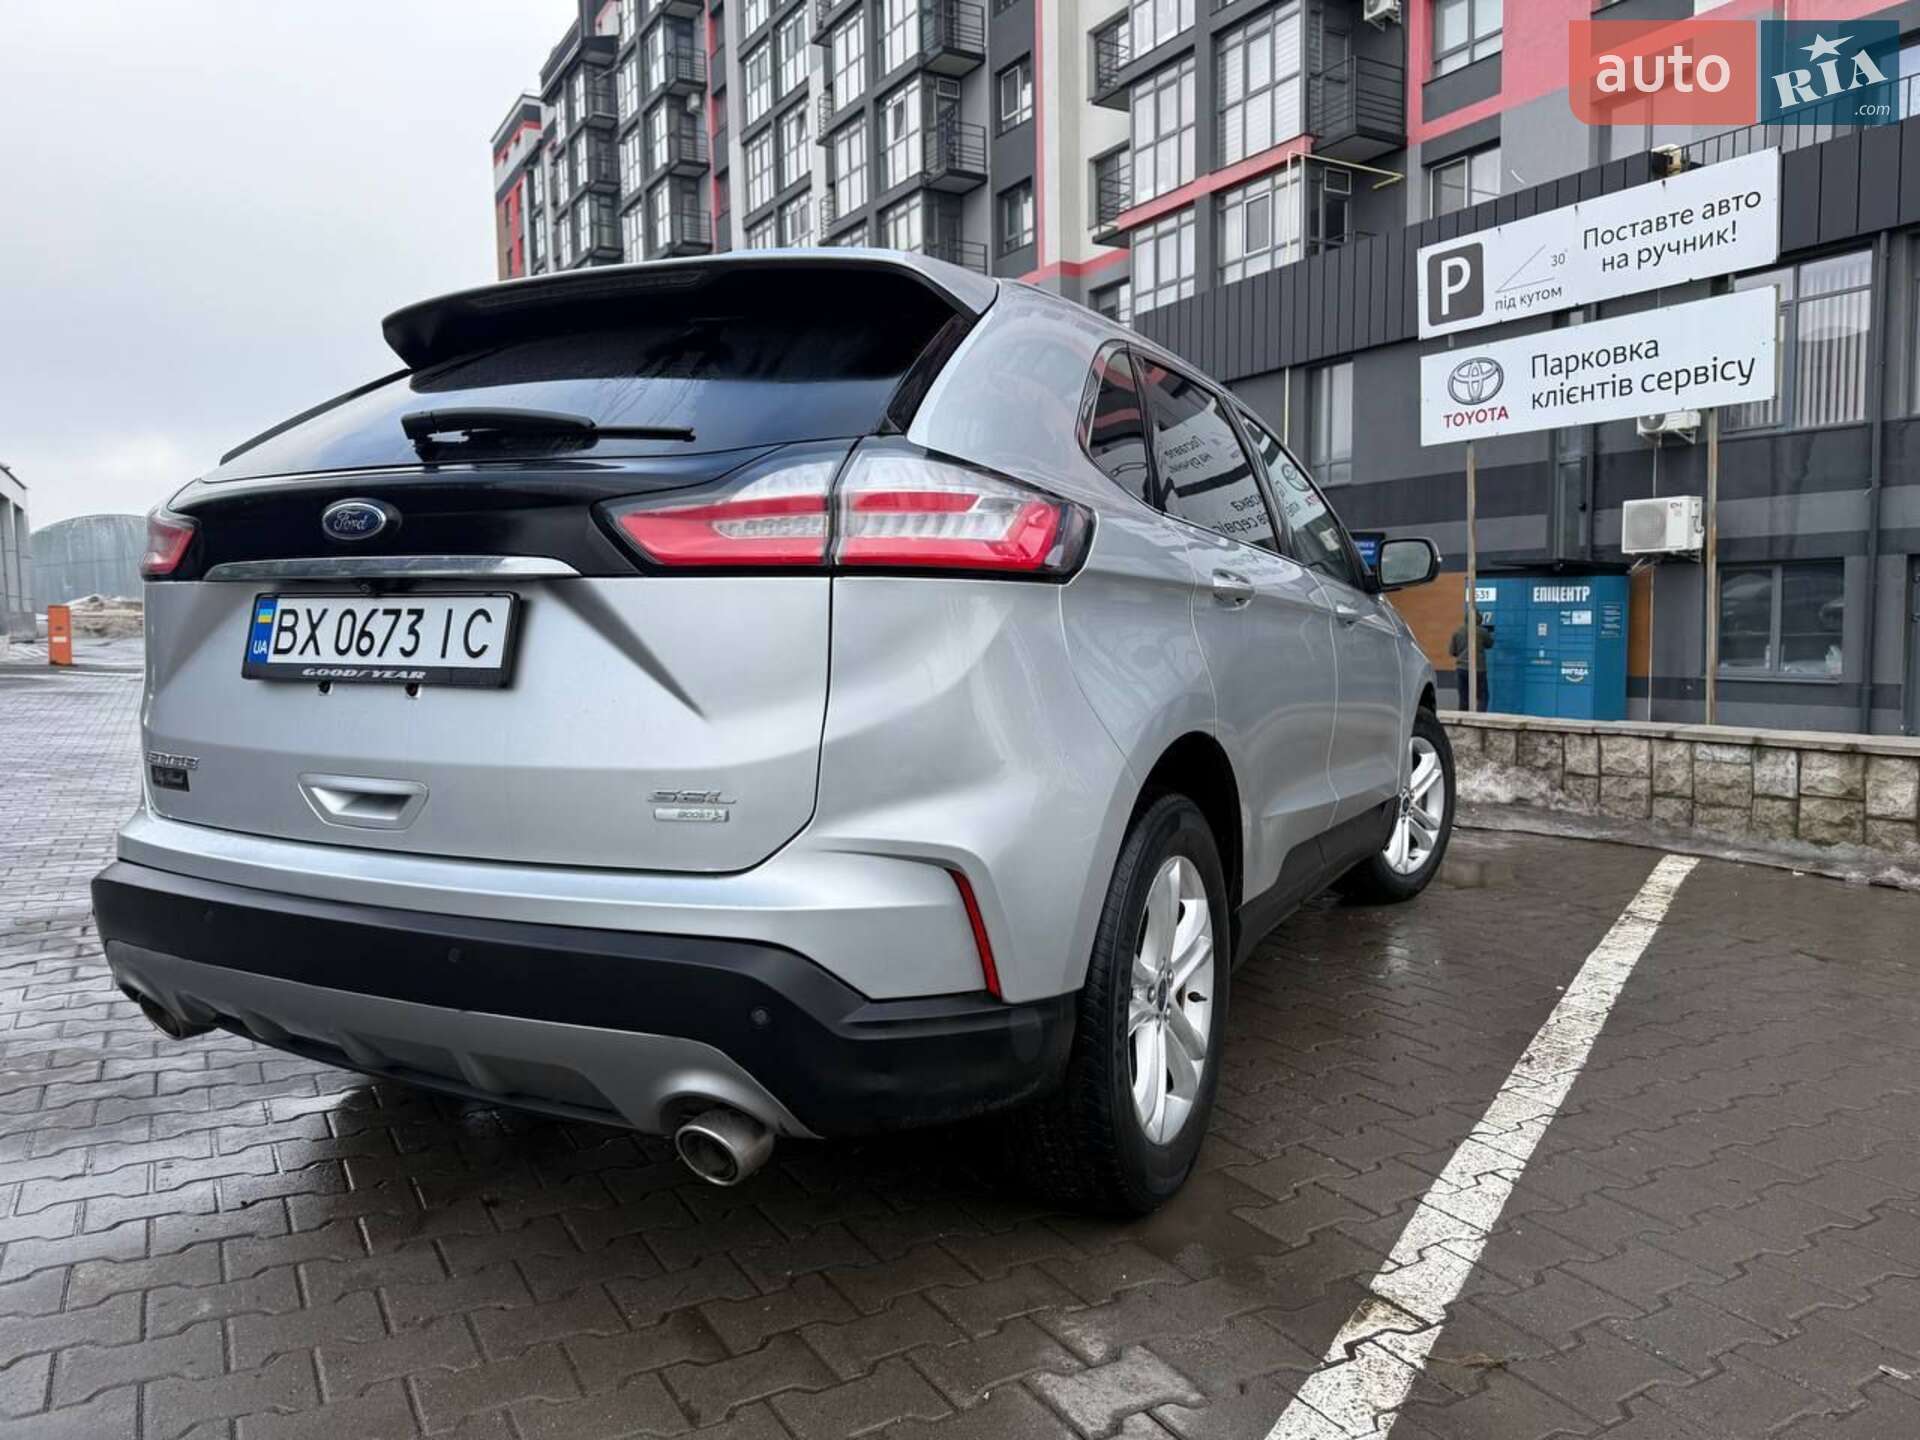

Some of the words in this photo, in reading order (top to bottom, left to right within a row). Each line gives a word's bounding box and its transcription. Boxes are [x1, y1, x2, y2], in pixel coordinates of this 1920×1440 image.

[1583, 208, 1694, 250] Поставте
[1702, 191, 1761, 220] авто
[1602, 252, 1629, 272] на
[1637, 220, 1737, 270] ручник!
[1441, 256, 1471, 316] P
[1495, 297, 1518, 311] під
[1520, 287, 1562, 308] кутом
[1531, 339, 1659, 379] Парковка
[1531, 374, 1633, 410] клієнтів
[1640, 356, 1756, 395] сервісу
[1443, 406, 1510, 429] TOYOTA
[334, 510, 368, 531] Ford
[1533, 586, 1590, 602] ЕПІЦЕНТР
[253, 641, 268, 654] UA
[272, 608, 328, 656] BX
[334, 608, 425, 658] 0673
[441, 608, 492, 659] IC
